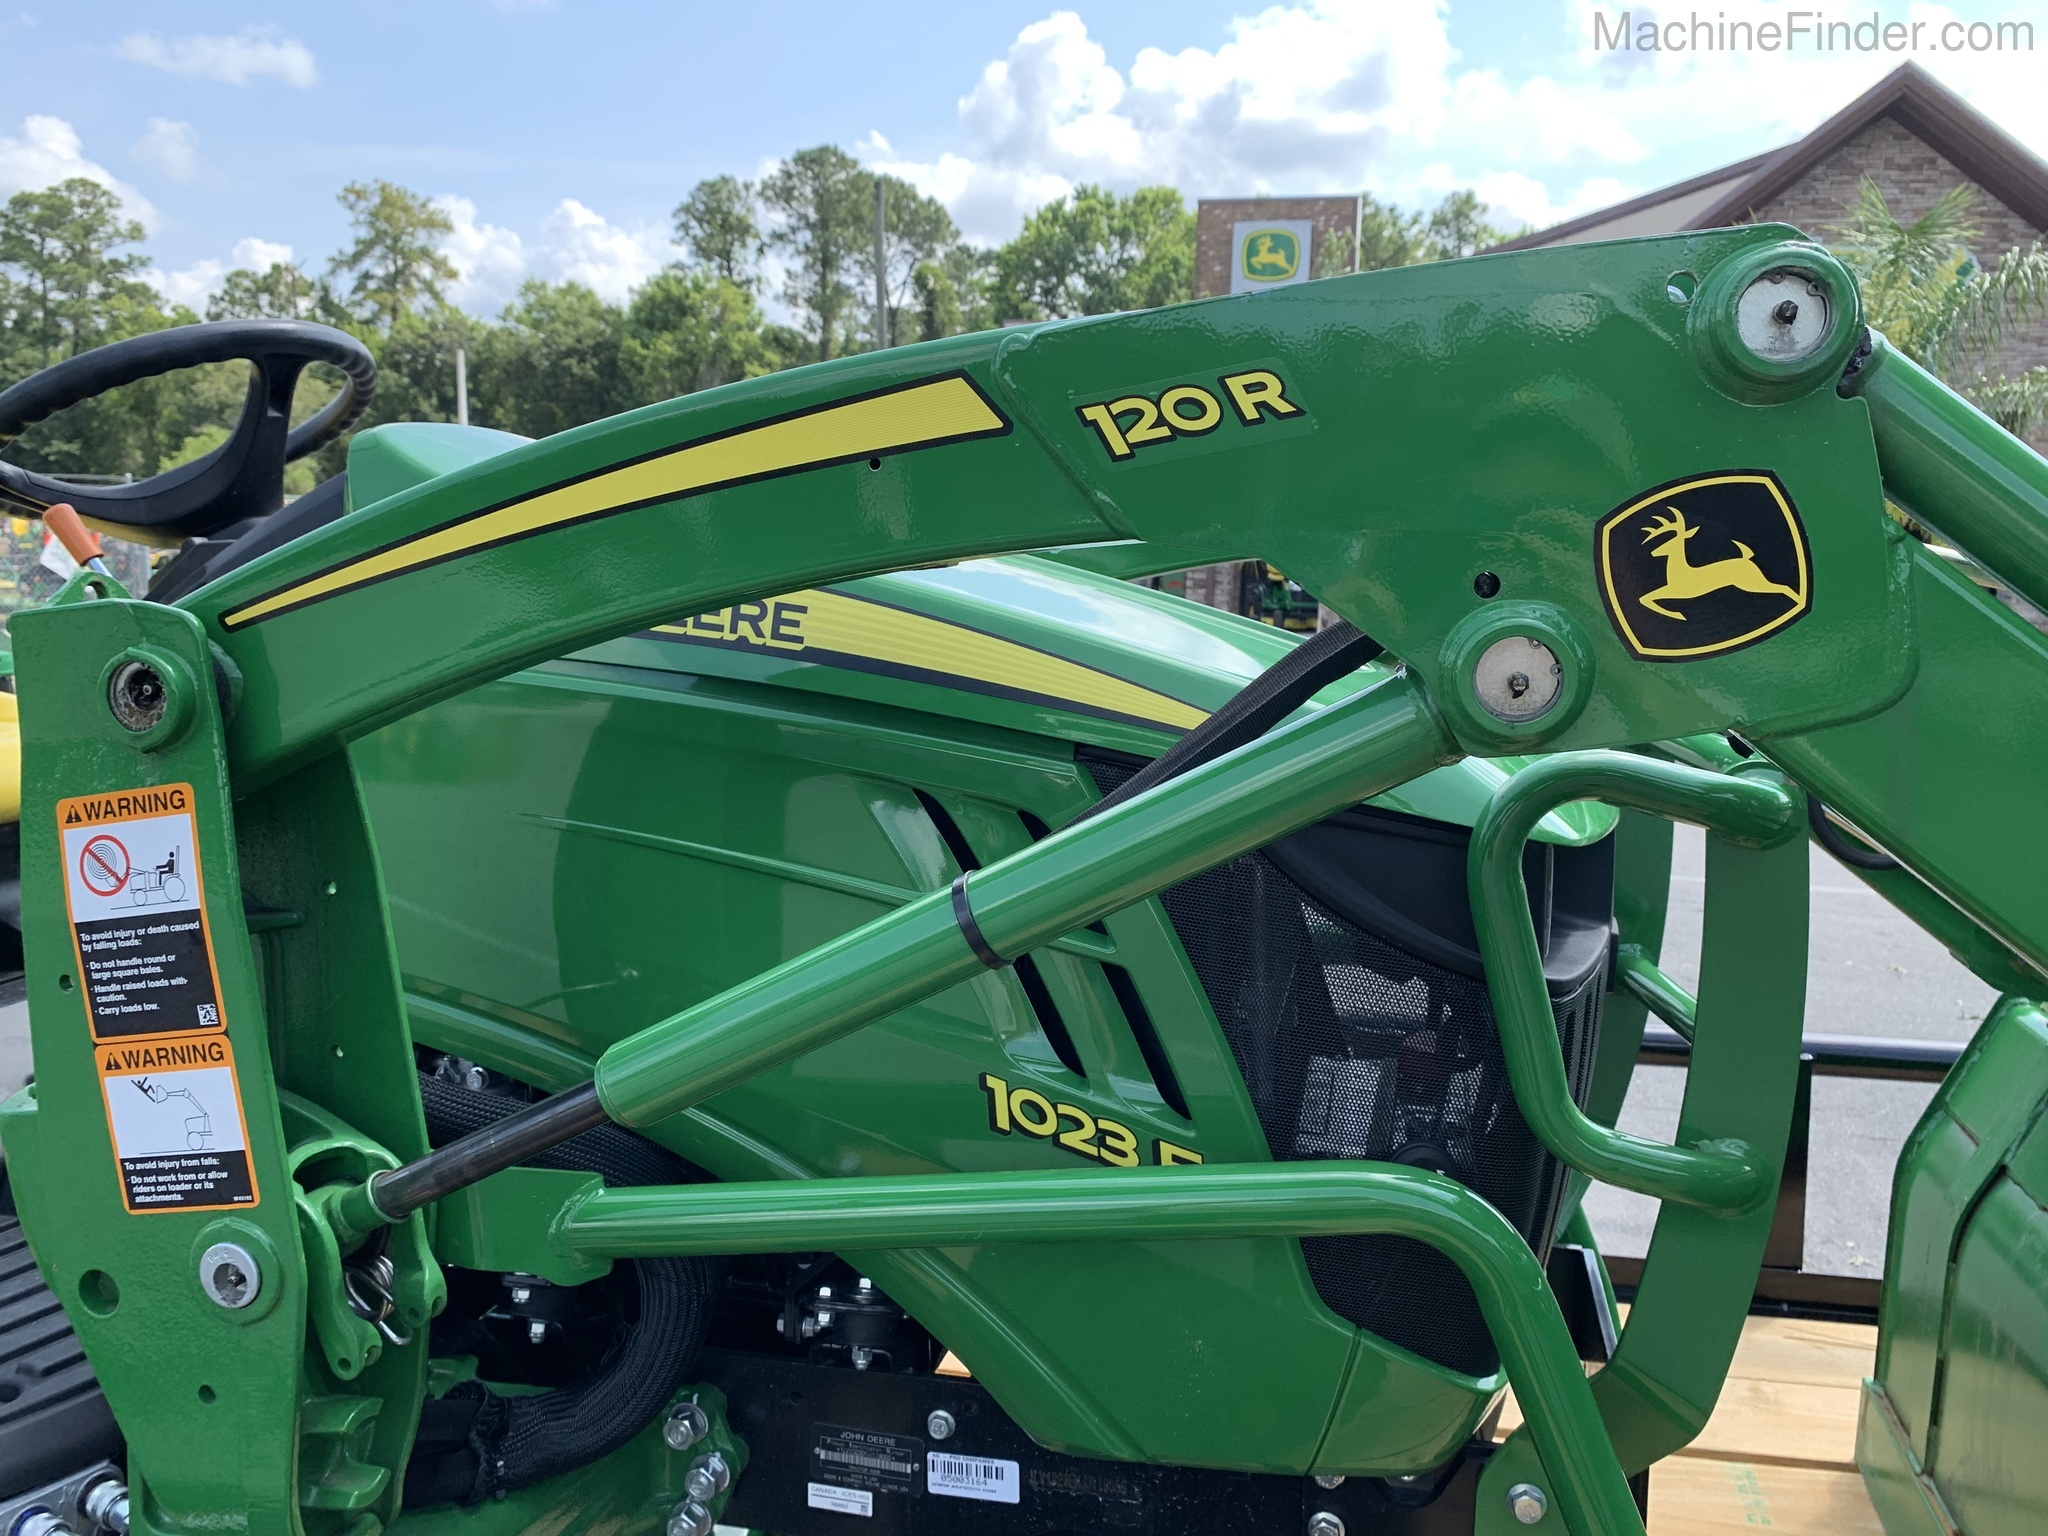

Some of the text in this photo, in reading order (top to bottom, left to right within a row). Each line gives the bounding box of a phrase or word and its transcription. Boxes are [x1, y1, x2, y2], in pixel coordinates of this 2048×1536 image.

[1077, 370, 1303, 460] 120 R
[660, 599, 808, 647] ERE
[83, 790, 185, 820] WARNING
[92, 931, 112, 940] avoid
[114, 929, 135, 939] injury
[147, 924, 168, 934] death
[170, 921, 199, 932] caused
[82, 938, 142, 952] by falling loads:
[103, 960, 115, 968] not
[116, 957, 142, 966] handle
[144, 954, 166, 964] round
[92, 965, 163, 980] large square bales.
[94, 984, 121, 993] Handle
[123, 981, 146, 990] raised
[148, 978, 169, 987] loads
[97, 994, 127, 1003] caution.
[99, 1002, 159, 1015] Carry loads low.
[121, 1042, 224, 1068] WARNING
[981, 1073, 1140, 1167] 1023
[124, 1157, 219, 1170] To avoid injury from falls:
[144, 1175, 157, 1183] not
[158, 1174, 176, 1182] work
[178, 1172, 196, 1181] from
[208, 1171, 228, 1179] allow
[133, 1184, 155, 1193] riders
[168, 1182, 192, 1191] loader
[204, 1181, 214, 1189] its
[135, 1194, 184, 1203] attachments.
[841, 1431, 896, 1446] JOHN DEERE
[811, 1486, 837, 1495] CANADA
